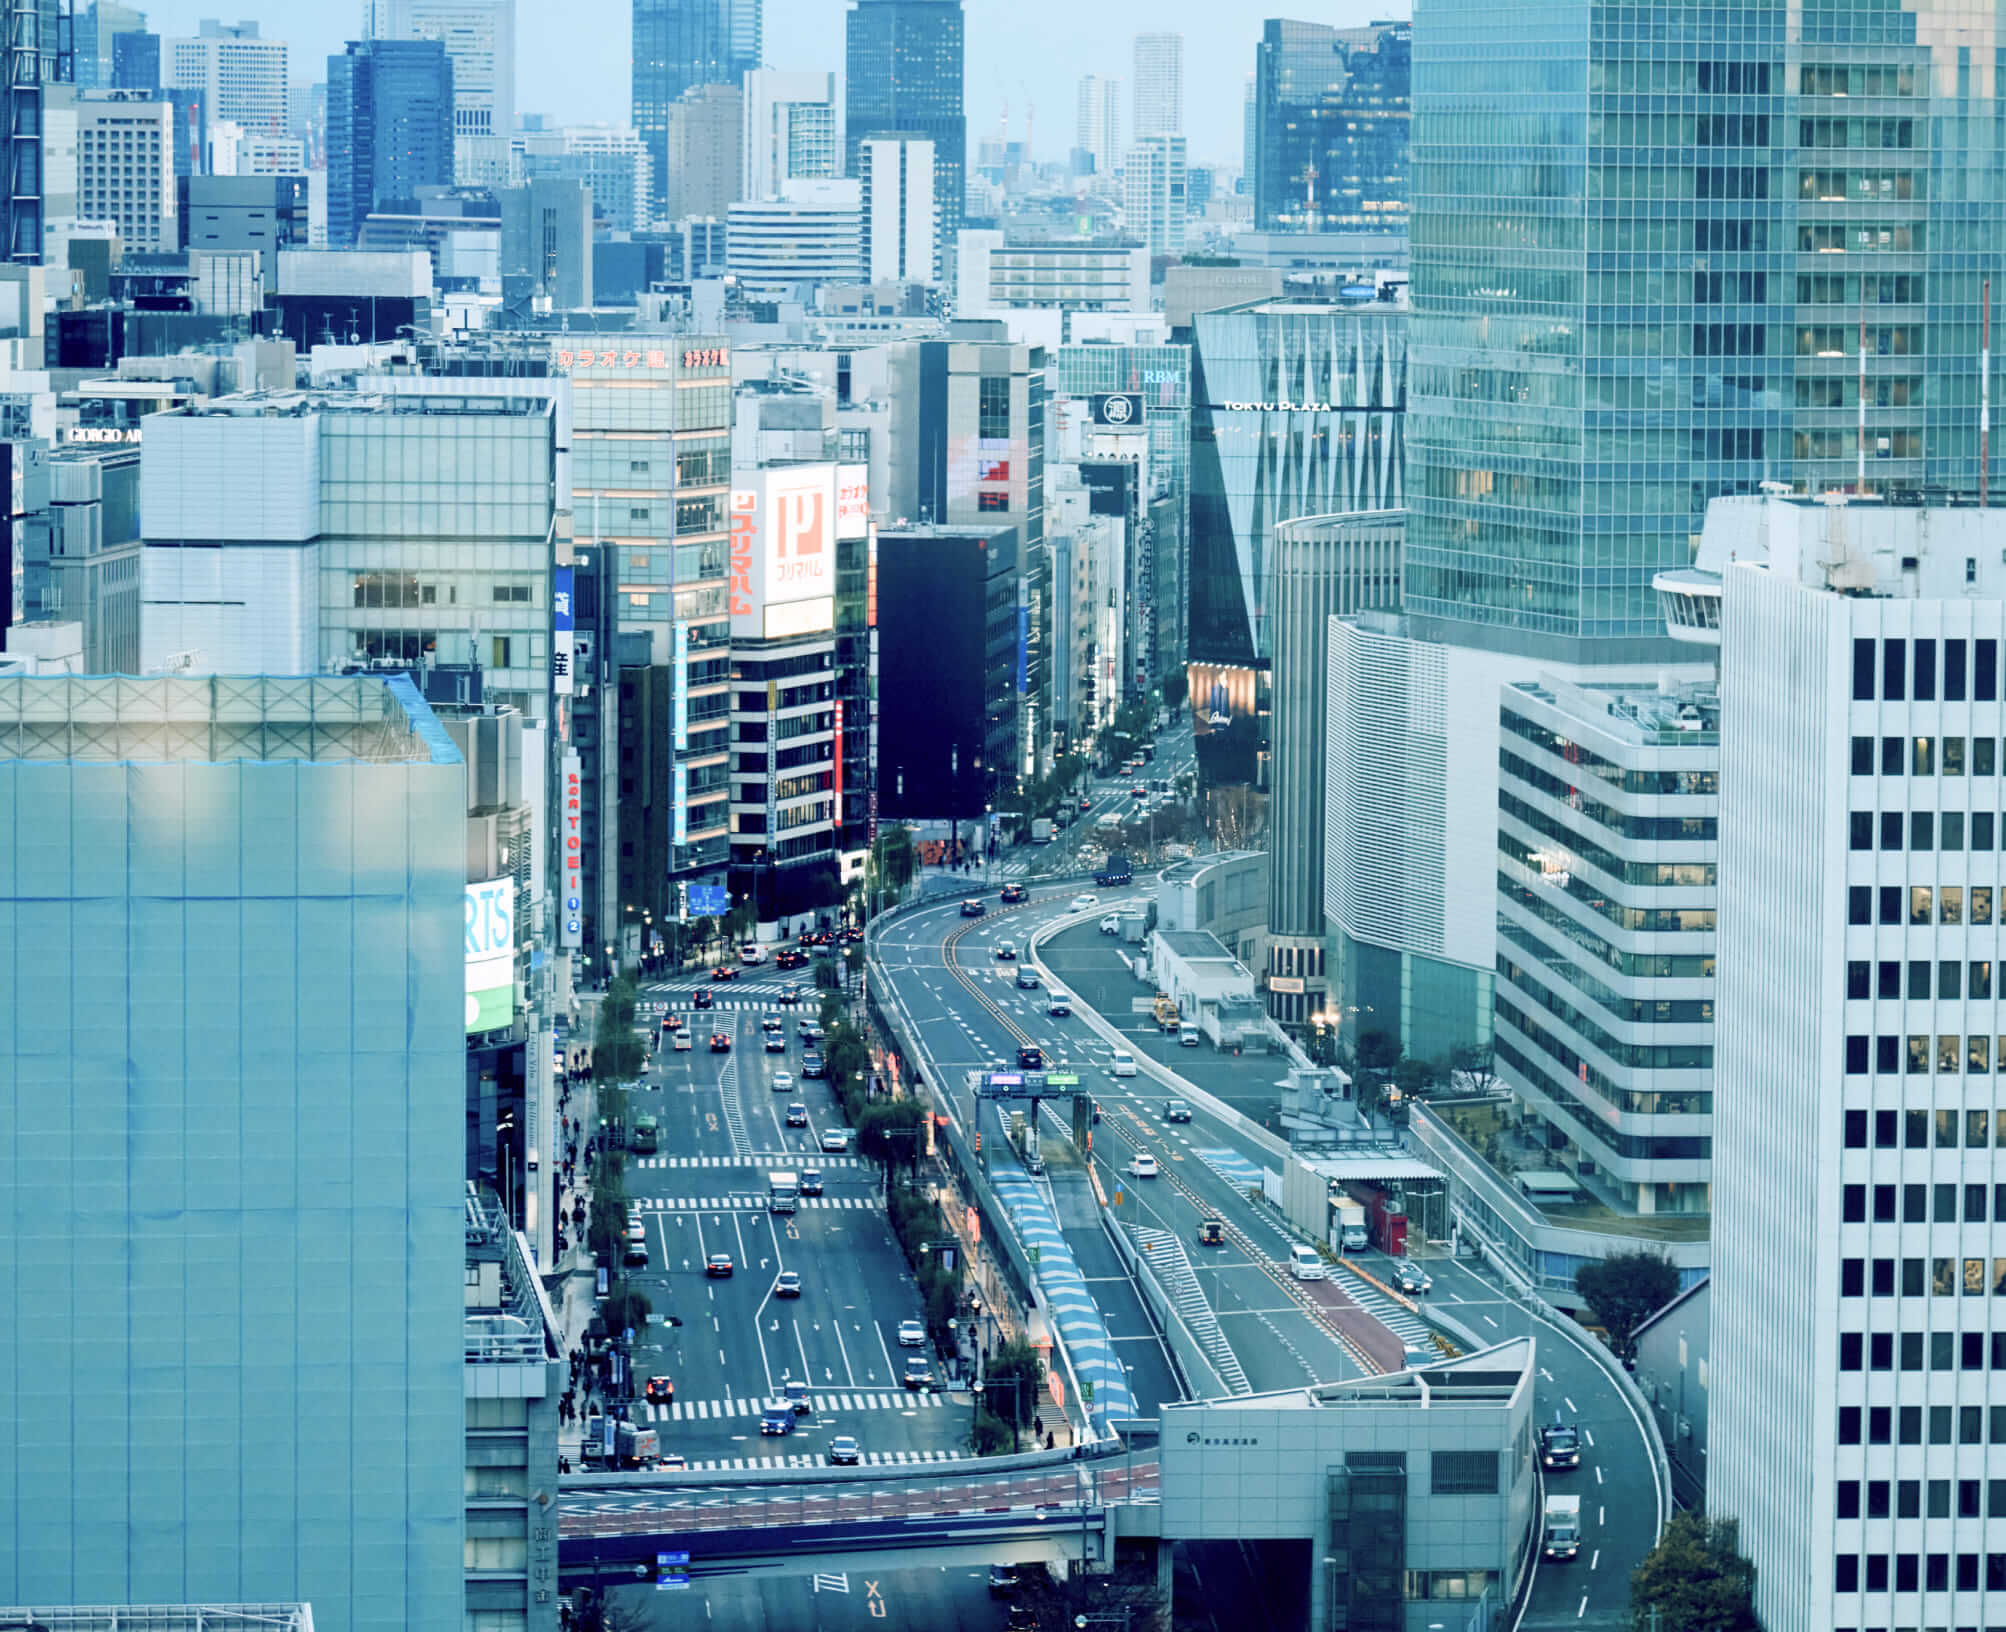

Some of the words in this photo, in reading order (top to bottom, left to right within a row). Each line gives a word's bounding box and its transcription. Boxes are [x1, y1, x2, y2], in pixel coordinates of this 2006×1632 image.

[559, 349, 665, 368] カラオケ館
[1144, 370, 1181, 384] RBM
[1223, 400, 1275, 412] TOKYU
[1278, 401, 1331, 412] PLAZA
[69, 428, 121, 442] GIORGIO
